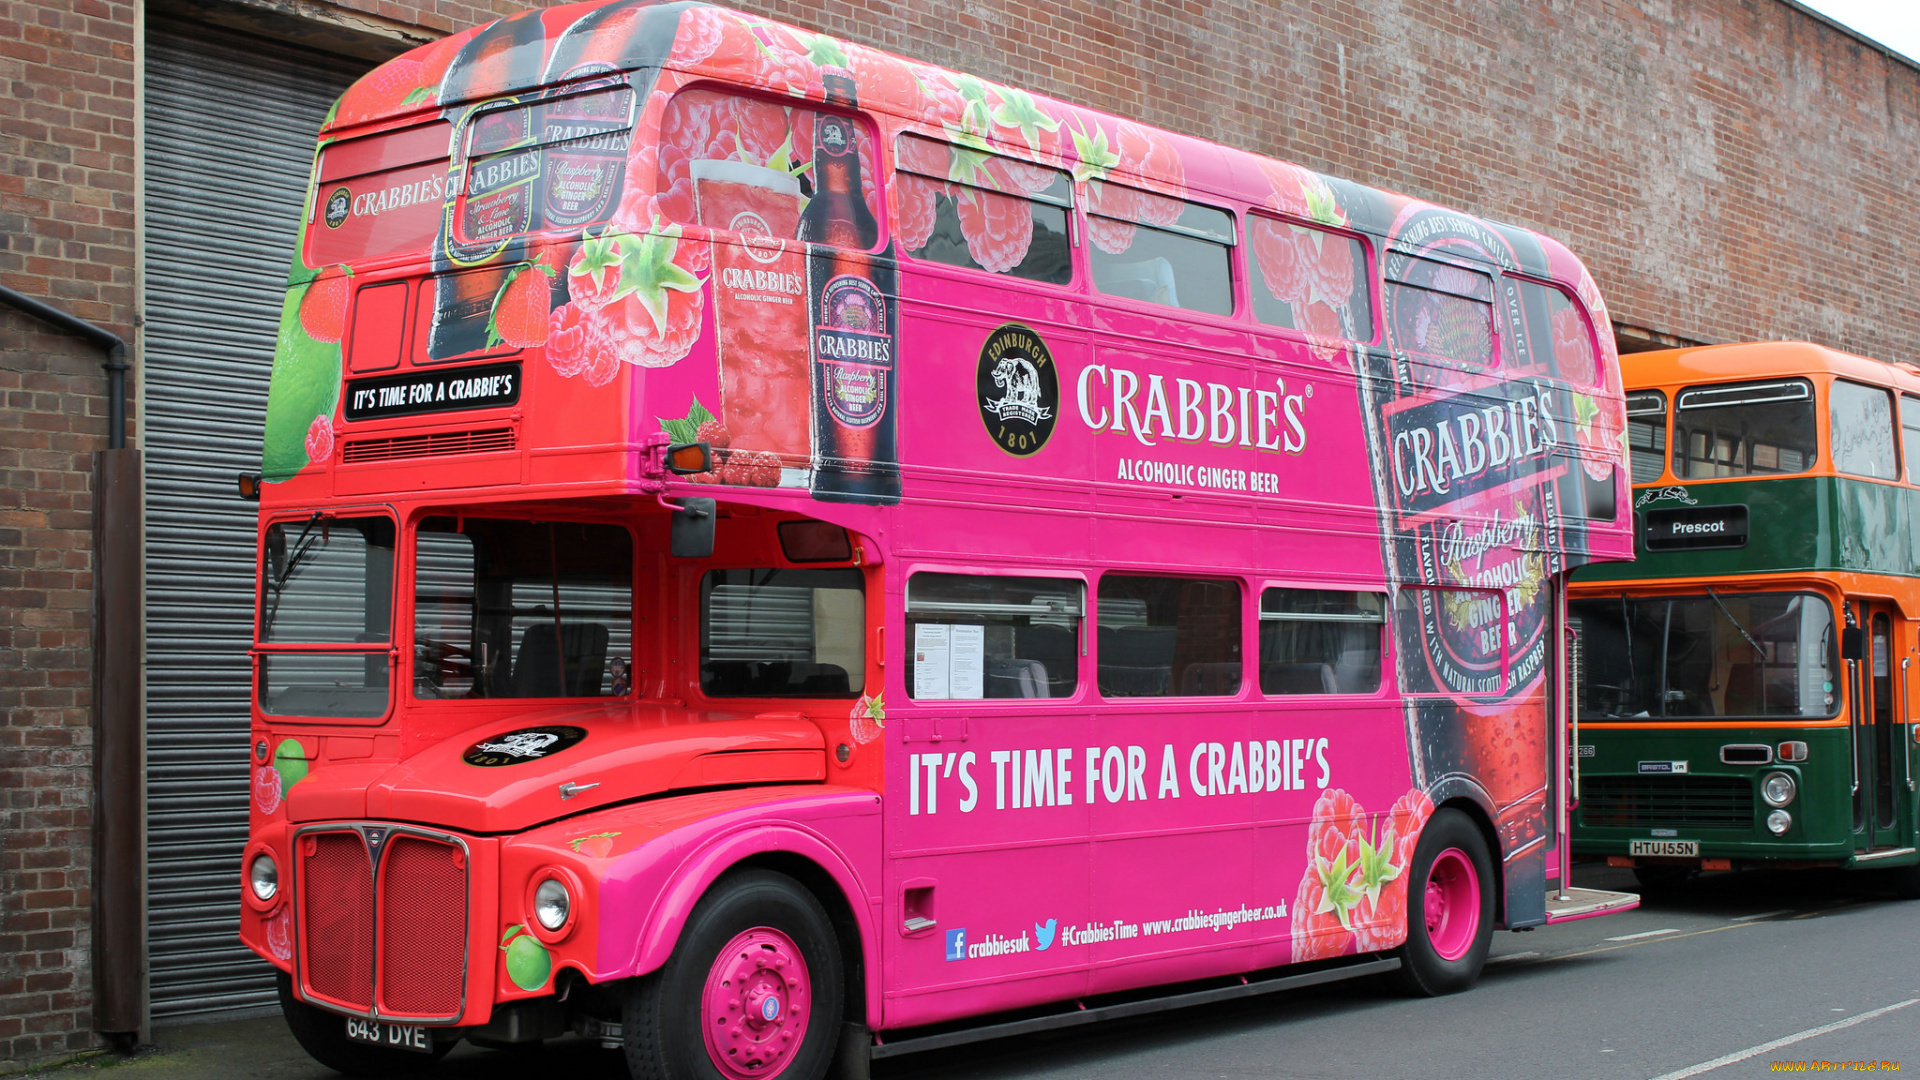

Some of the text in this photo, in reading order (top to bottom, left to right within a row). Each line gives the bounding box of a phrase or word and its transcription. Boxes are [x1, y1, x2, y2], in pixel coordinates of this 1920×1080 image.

[545, 124, 630, 151] CRABBIE'S
[555, 161, 603, 181] Raspberry
[559, 180, 594, 192] ALCOHOLIC
[353, 173, 443, 216] CRABBIE'S
[561, 191, 586, 201] GINGER
[562, 201, 579, 211] BEER
[478, 217, 511, 236] ALCOHOLIC
[1428, 216, 1448, 234] BEST
[1447, 216, 1480, 240] SERVED
[1482, 231, 1513, 271] CHILLE
[723, 268, 803, 295] CRABBIE'S
[735, 293, 762, 301] ALCOHOLIC
[762, 295, 781, 304] GINGER
[1506, 287, 1526, 356] OVER ICE
[819, 335, 890, 361] CRABBIE'S
[988, 333, 1047, 368] EDINBURGH
[833, 366, 876, 386] Raspberry
[840, 384, 871, 395] ALCOHOLIC
[353, 374, 512, 410] IT'S TIME FOR A CRABBIE'S
[848, 403, 863, 412] BEER
[1076, 364, 1308, 454] CRABBIE'S
[998, 425, 1037, 449] 1801
[1394, 380, 1557, 495] CRABBIE'S
[1118, 458, 1279, 494] ALCOHOLIC GINGER BEER
[1545, 491, 1556, 545] GINGER
[1672, 520, 1725, 534] Prescot
[1440, 508, 1535, 570] Raspberry
[1456, 553, 1531, 605] ALCOHOLIC
[1469, 588, 1523, 629] GINGER
[1480, 621, 1518, 655] BEER
[1425, 620, 1443, 667] WITH
[1442, 661, 1475, 693] NATURAL
[1517, 636, 1545, 682] RASPBER
[469, 752, 510, 765] 1801
[910, 737, 1331, 815] IT'S TIME FOR A CRABBIE'S
[1061, 898, 1288, 947] #CrabbiesTime www.crabbiesgingerbeer.co.uk
[968, 931, 1030, 959] crabbiesuk
[347, 1017, 426, 1048] 643 DYE
